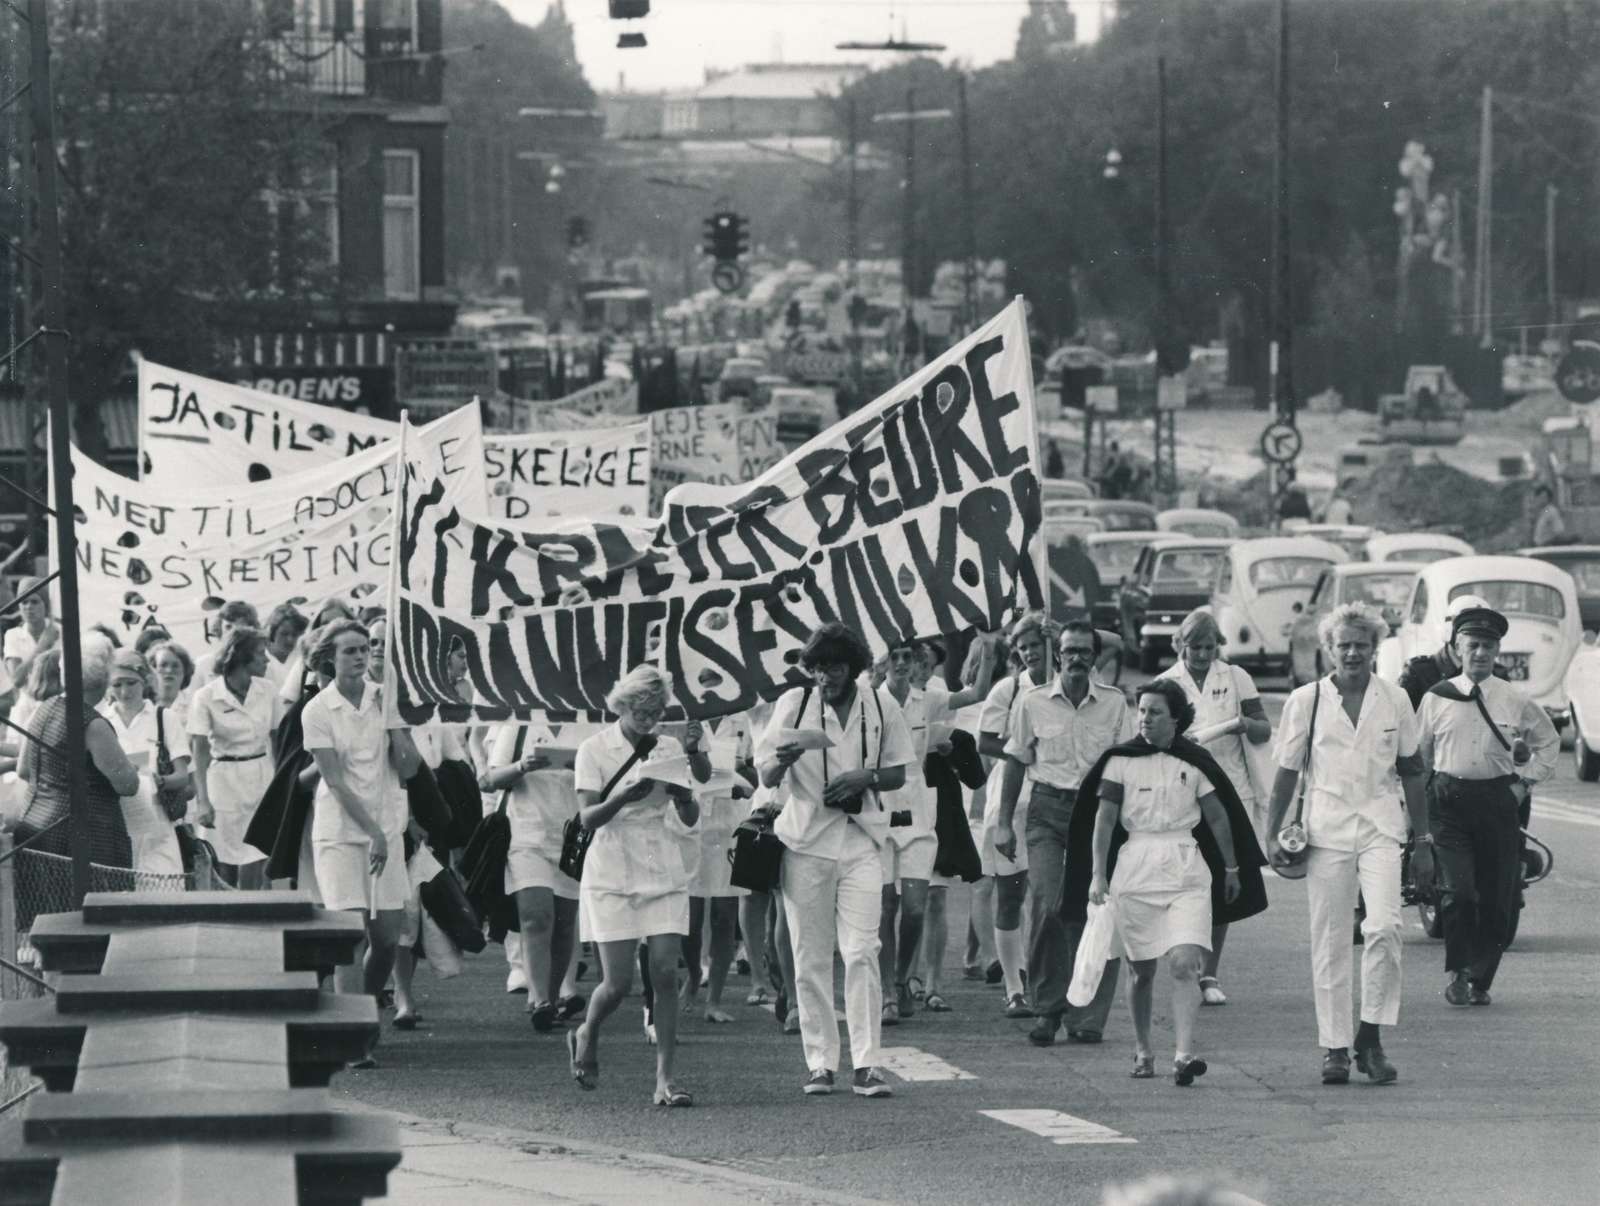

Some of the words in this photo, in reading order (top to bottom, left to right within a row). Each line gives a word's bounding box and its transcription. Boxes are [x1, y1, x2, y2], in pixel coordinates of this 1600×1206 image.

[149, 382, 209, 430] JA
[95, 485, 175, 536] NEJ
[400, 463, 461, 609] VI
